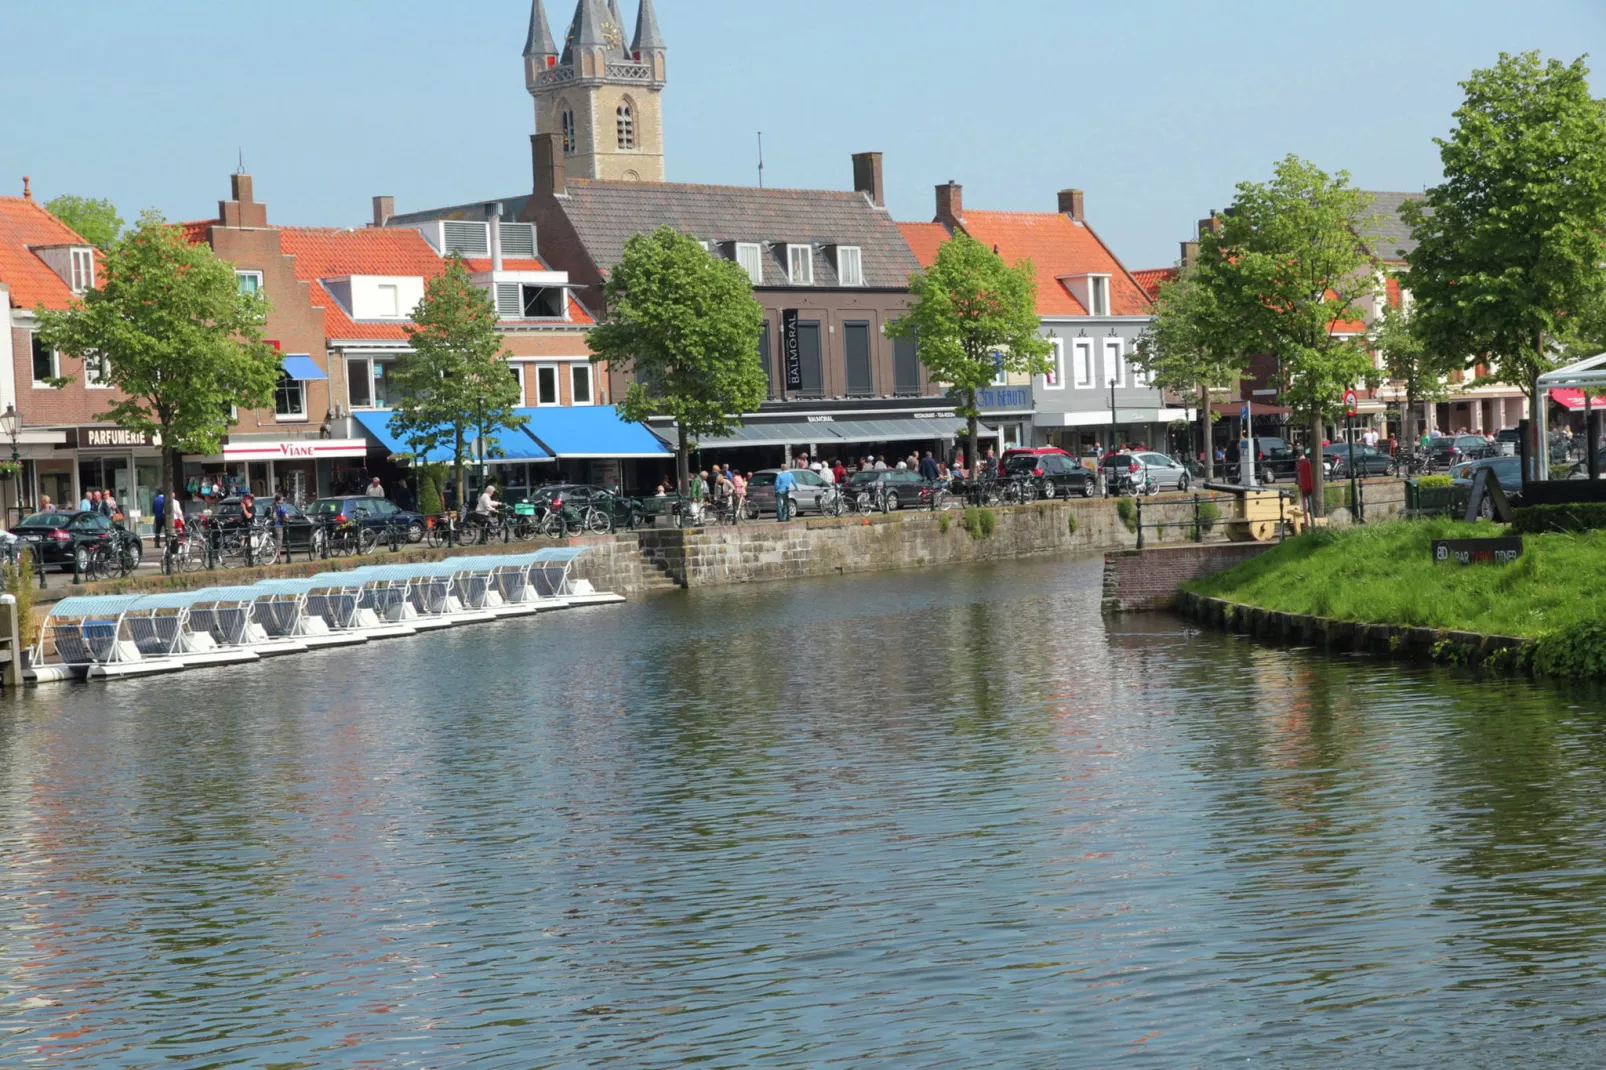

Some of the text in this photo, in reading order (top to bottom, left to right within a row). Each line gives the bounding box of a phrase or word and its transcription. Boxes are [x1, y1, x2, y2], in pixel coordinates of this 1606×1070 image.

[788, 314, 800, 384] BALMORAL
[997, 389, 1028, 406] BEAUTY
[88, 429, 146, 445] PARFUMERIE
